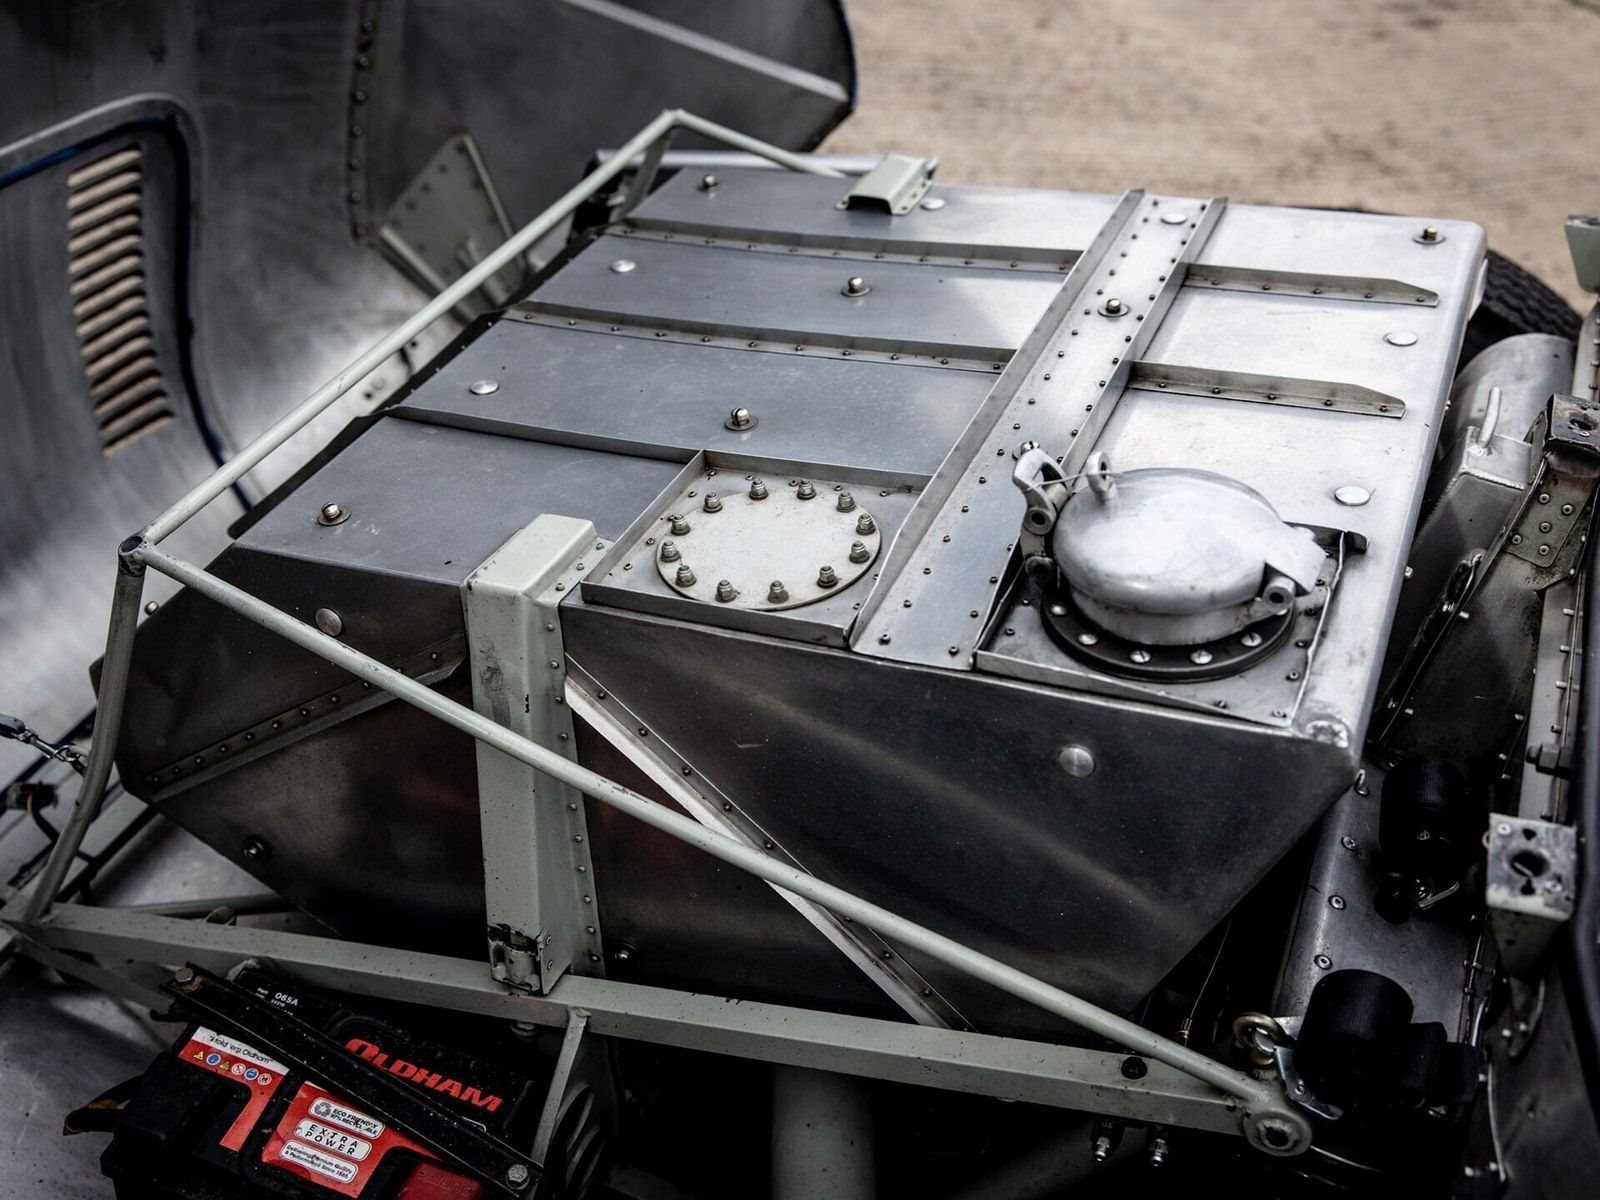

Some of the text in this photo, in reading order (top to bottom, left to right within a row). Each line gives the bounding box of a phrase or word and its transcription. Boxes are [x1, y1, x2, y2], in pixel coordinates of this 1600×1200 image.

[274, 992, 299, 1006] 065A
[345, 1038, 503, 1112] OLDHAM
[332, 1108, 347, 1117] ECO
[342, 1117, 378, 1135] RECYCLBLE
[305, 1131, 355, 1156] POWER
[309, 1124, 358, 1148] EXTRA
[321, 1163, 335, 1173] Since
